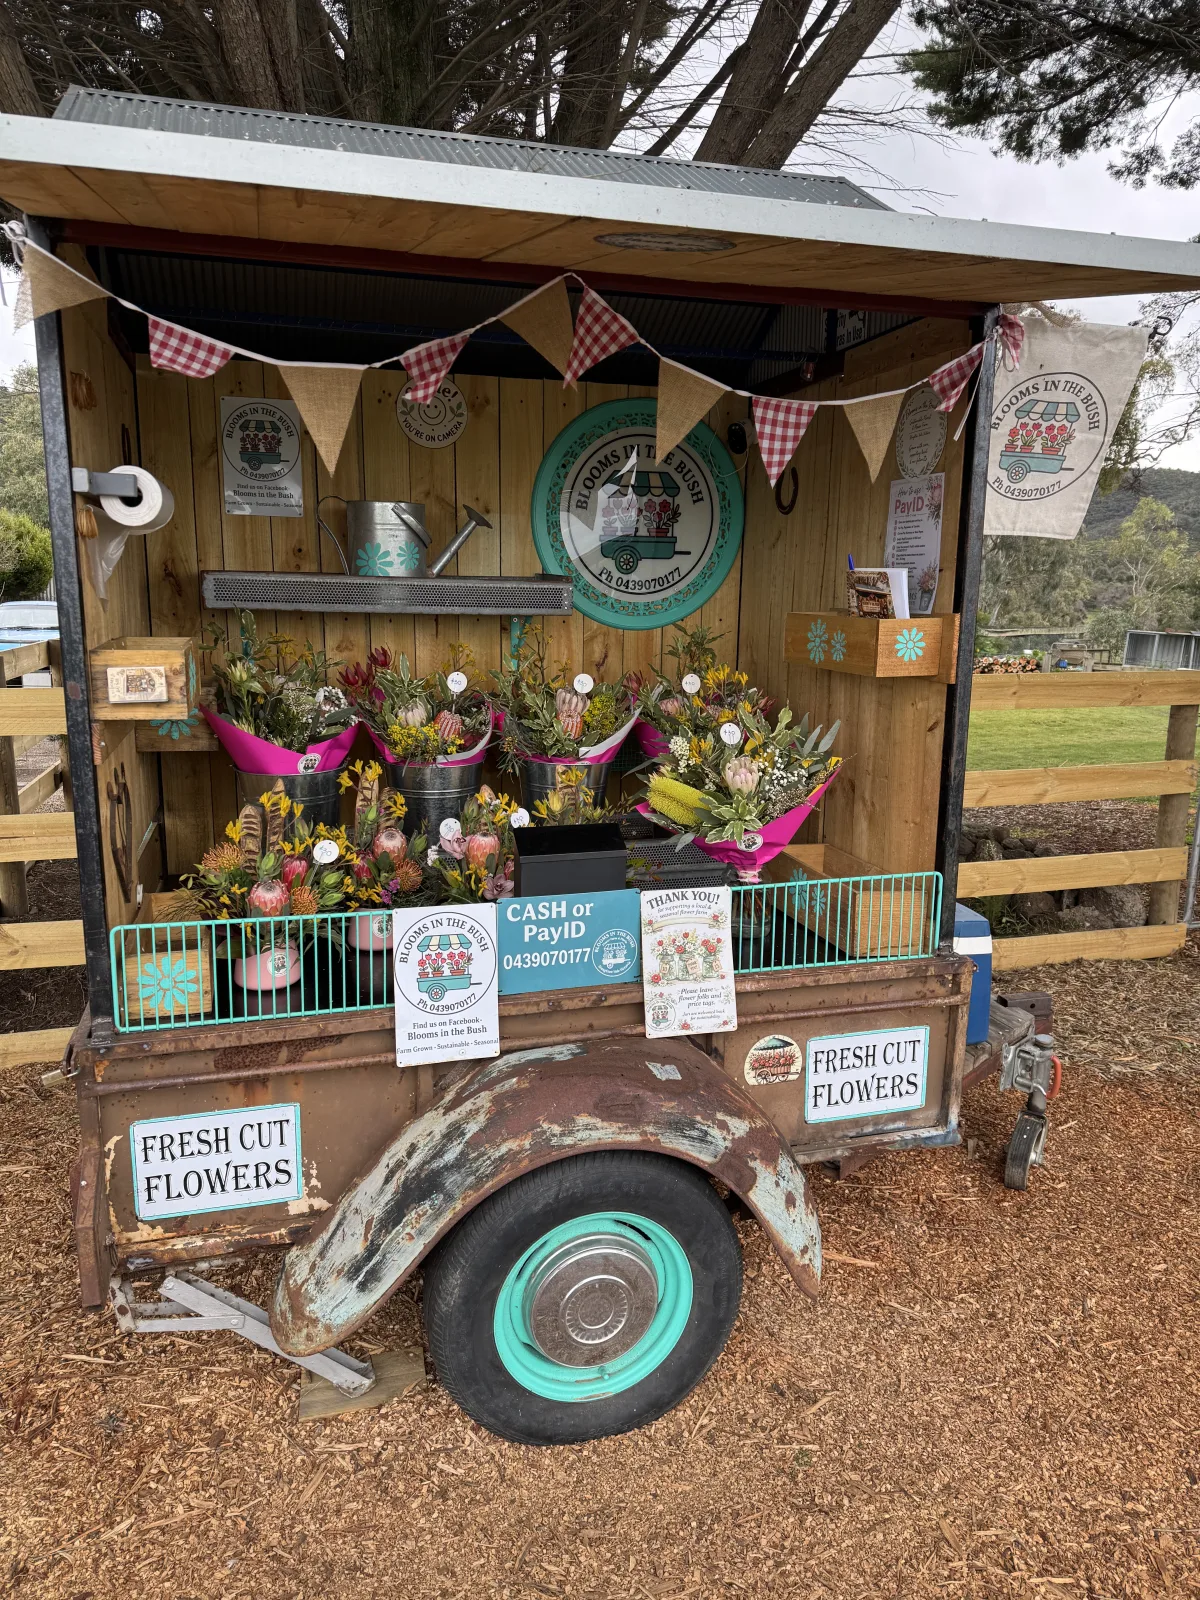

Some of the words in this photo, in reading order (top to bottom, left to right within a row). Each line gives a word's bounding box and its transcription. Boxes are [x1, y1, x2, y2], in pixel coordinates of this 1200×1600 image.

[990, 382, 1040, 430] BLOOMS
[1043, 380, 1061, 391] IN
[1062, 380, 1086, 398] THE
[1080, 392, 1100, 431] BUSH
[225, 409, 249, 439] BLOOMS
[249, 406, 259, 415] IN
[261, 407, 278, 418] THE
[277, 415, 295, 438] BUSH
[402, 417, 425, 440] YOU'RE
[425, 434, 436, 442] ON
[436, 420, 464, 442] CAMERA
[240, 466, 249, 476] Ph
[250, 467, 286, 479] 0439070177
[575, 449, 621, 511] BLOOMS
[623, 444, 641, 460] IN
[674, 460, 704, 505] BUSH
[233, 490, 257, 498] Blooms
[266, 491, 277, 499] the
[992, 476, 1004, 491] Ph
[1004, 480, 1062, 498] 0439070177
[894, 495, 925, 515] PayID
[598, 566, 614, 584] Ph
[616, 566, 682, 590] 0439070177
[506, 900, 567, 922] CASH
[572, 902, 594, 917] or
[647, 890, 690, 910] THANK
[691, 890, 720, 905] YOU!
[665, 903, 691, 912] supporting
[680, 908, 695, 916] flower
[694, 908, 708, 916] farm
[399, 923, 430, 964] BLOOMS
[431, 918, 443, 929] IN
[446, 917, 468, 930] THE
[467, 925, 490, 953] BUSH
[523, 921, 586, 945] PayID
[594, 933, 610, 953] BLOOMS
[626, 934, 636, 949] BUSH
[503, 947, 591, 970] 0439070177
[416, 998, 428, 1010] Ph
[429, 992, 477, 1013] 0439070177
[678, 995, 697, 1003] flower
[687, 1000, 702, 1009] price
[407, 1030, 439, 1041] Blooms
[440, 1028, 449, 1038] in
[451, 1027, 465, 1036] the
[466, 1024, 488, 1035] Bush
[412, 1021, 428, 1030] Find
[429, 1020, 438, 1028] us
[396, 1047, 412, 1055] Farm
[412, 1045, 434, 1053] Grown
[436, 1040, 470, 1050] Sustainable
[473, 1037, 499, 1046] Seasonal
[813, 1043, 878, 1076] FRESH
[882, 1039, 921, 1067] CUT
[812, 1072, 919, 1110] FLOWERS
[141, 1126, 232, 1164] FRESH
[239, 1119, 290, 1152] CUT
[144, 1158, 293, 1205] FLOWERS
